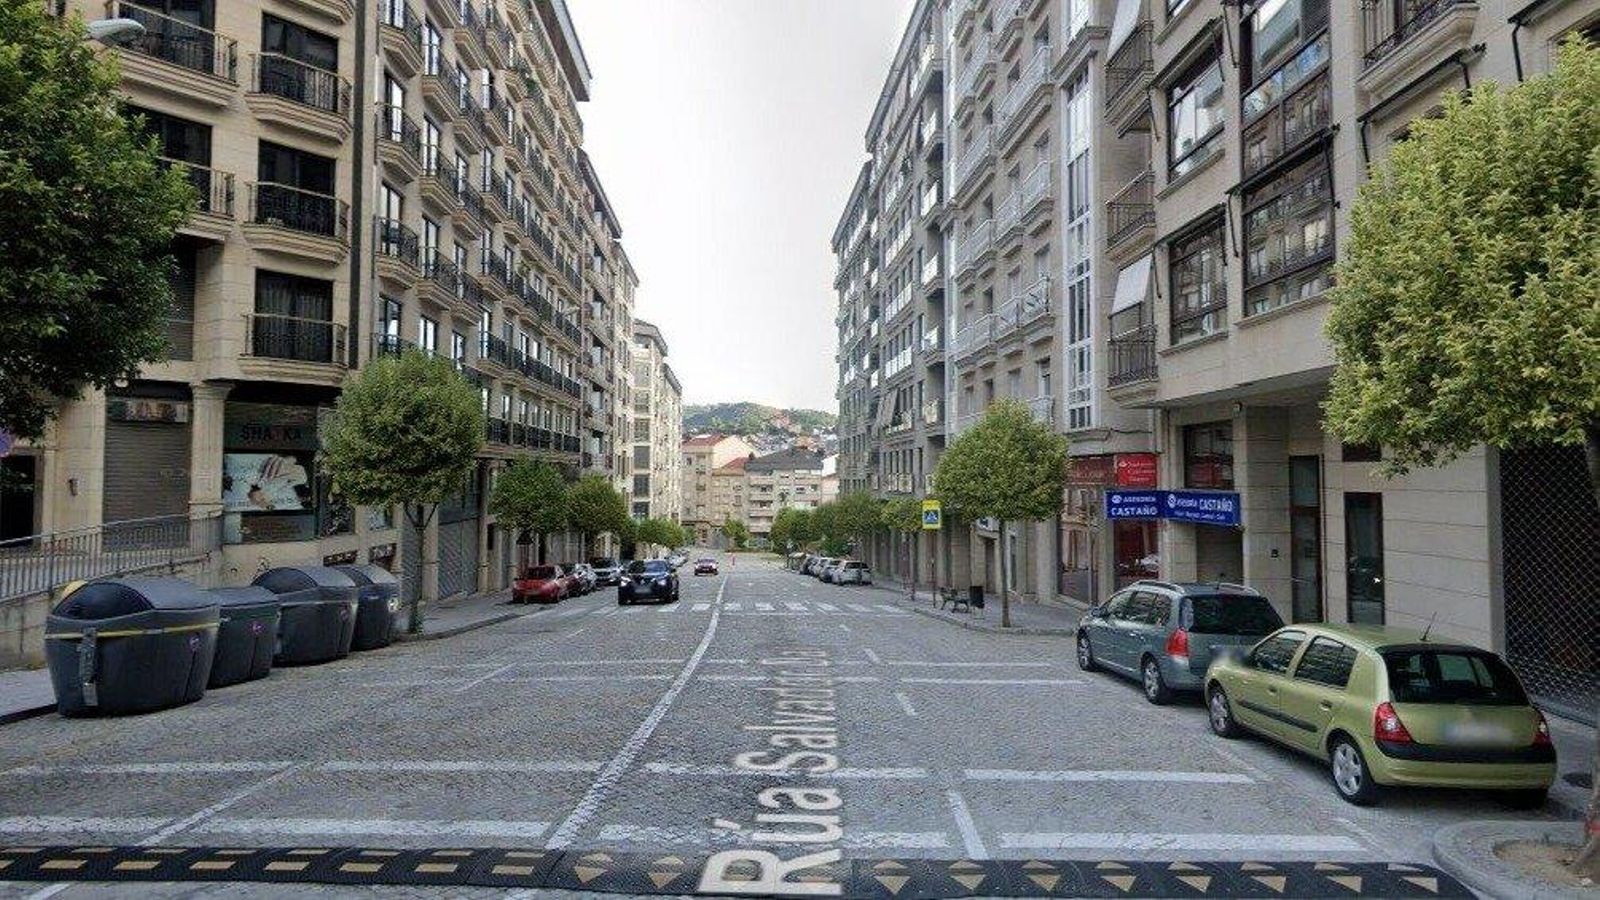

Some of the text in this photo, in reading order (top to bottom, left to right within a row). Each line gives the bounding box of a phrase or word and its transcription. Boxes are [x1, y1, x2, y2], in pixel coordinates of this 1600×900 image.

[240, 425, 304, 441] SHAKA
[1111, 505, 1158, 516] CASTAÑO
[1199, 498, 1233, 512] CASTAÑO
